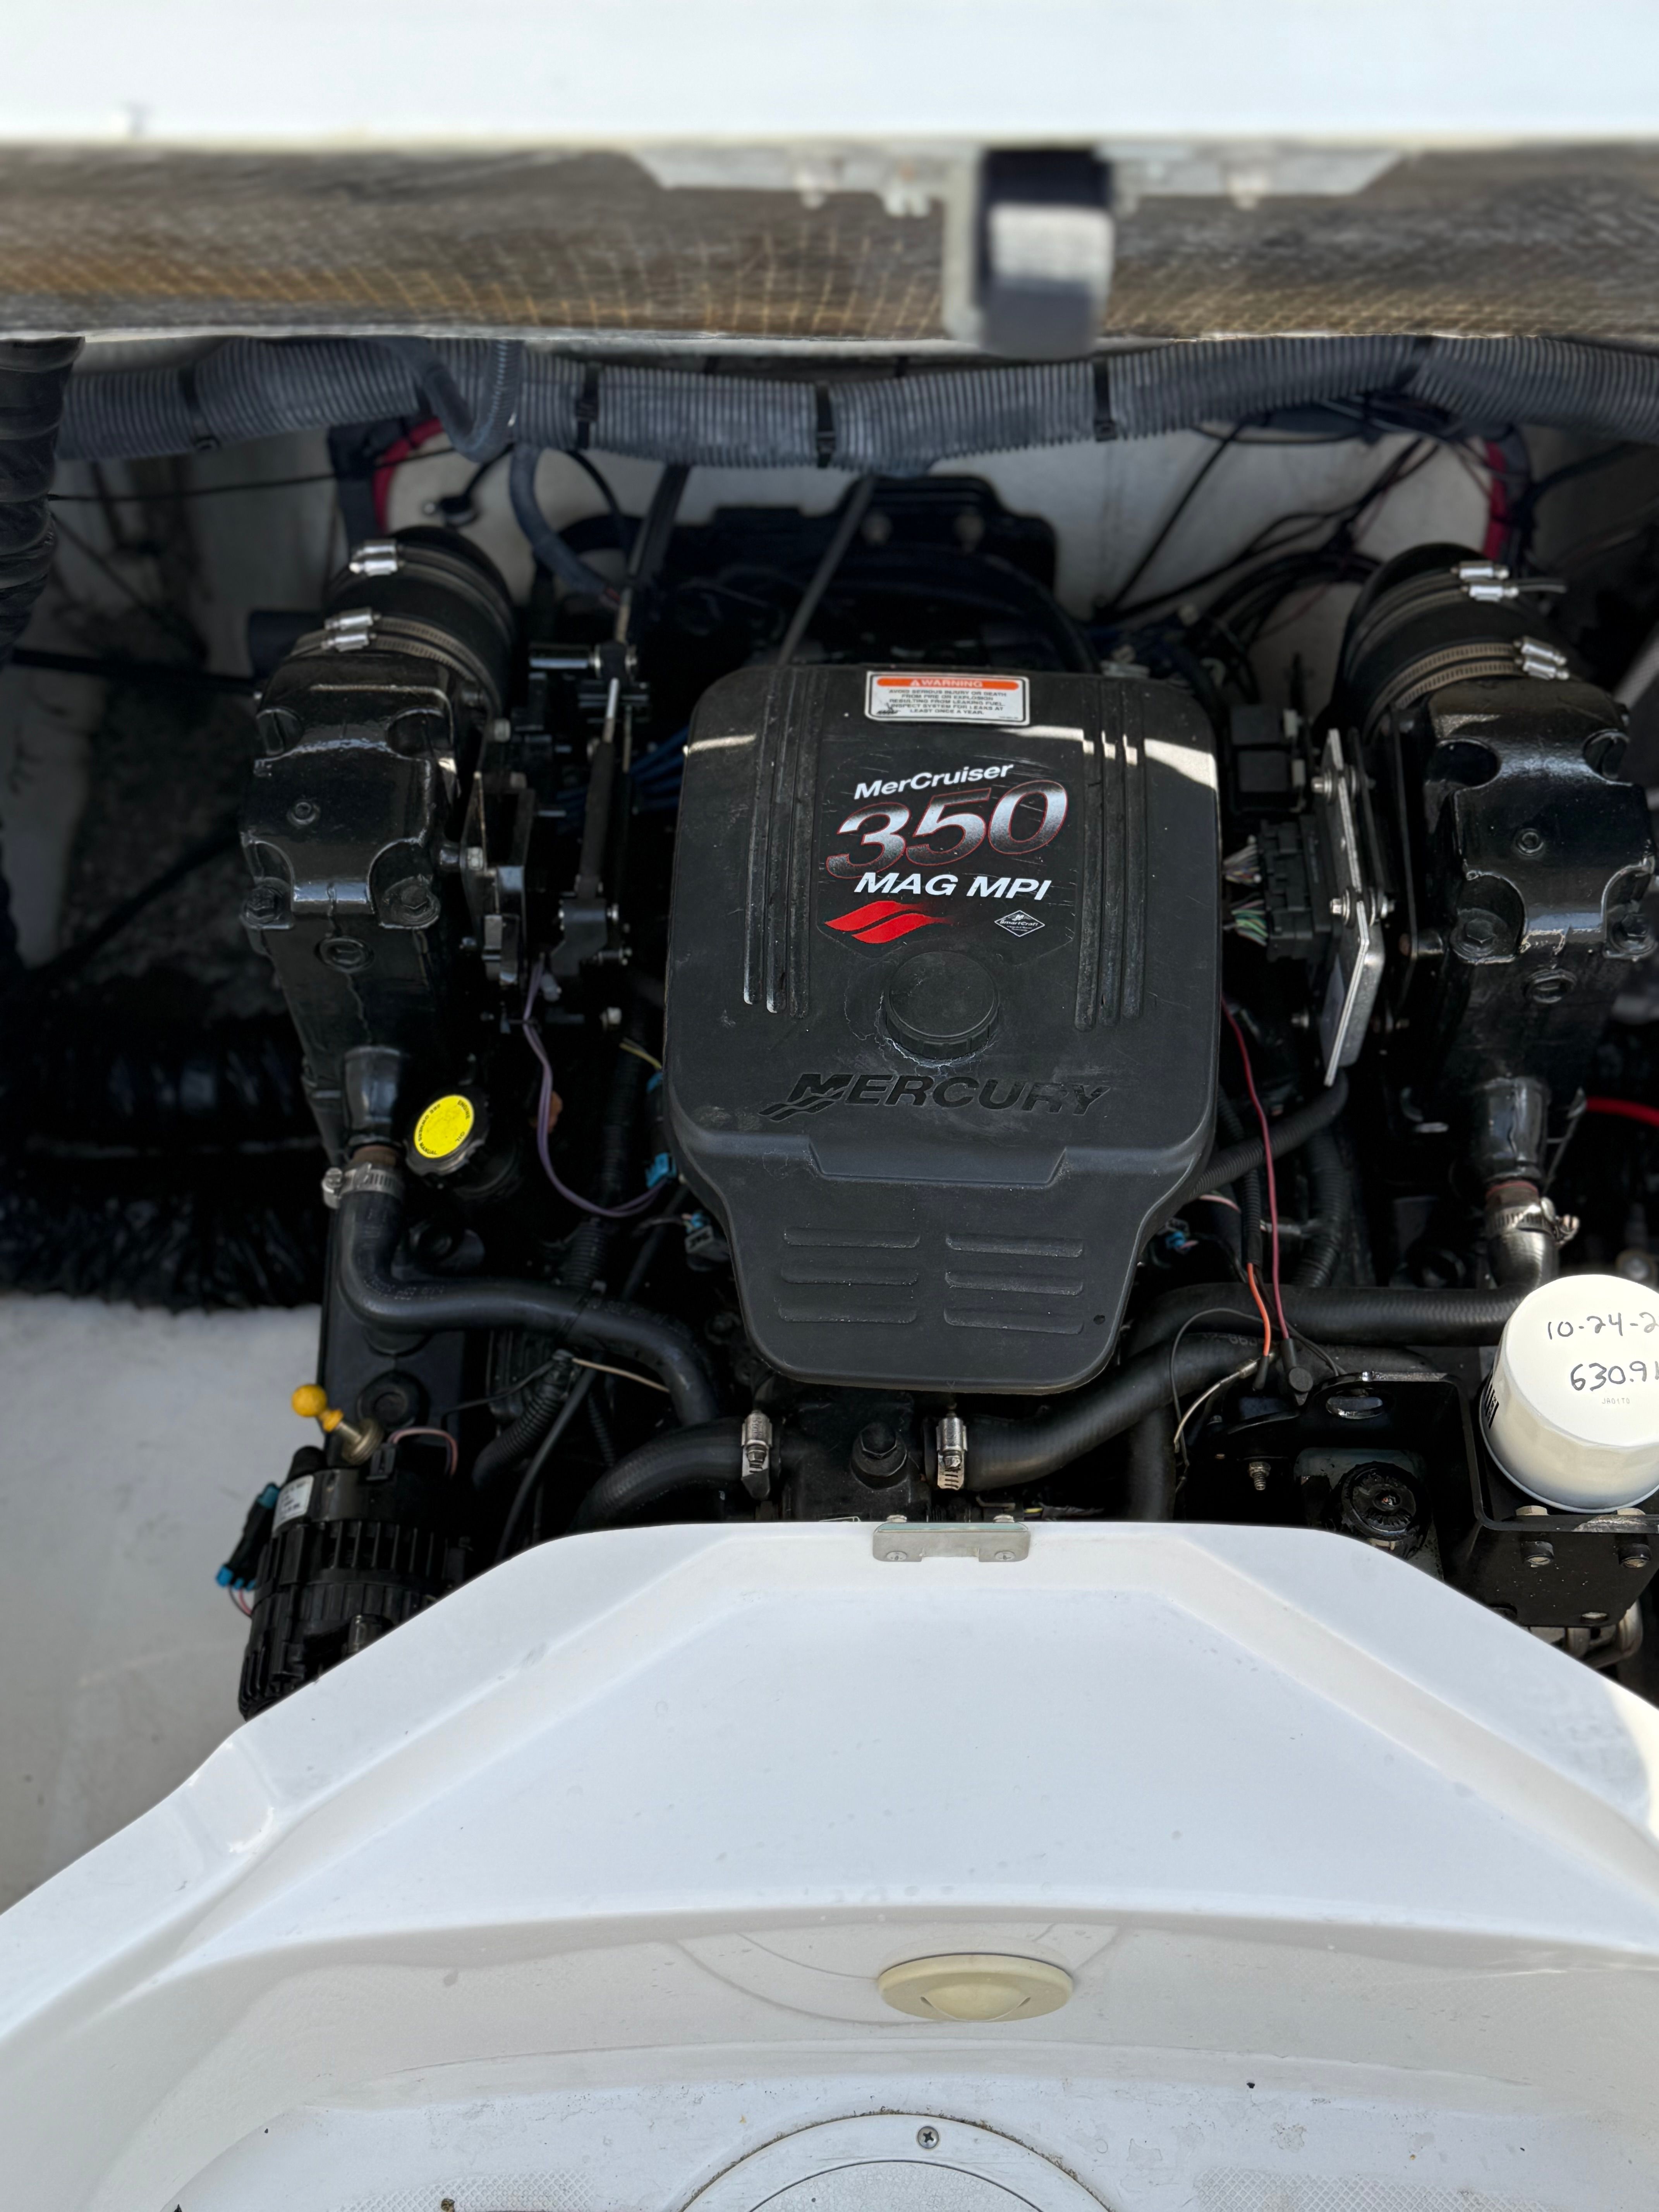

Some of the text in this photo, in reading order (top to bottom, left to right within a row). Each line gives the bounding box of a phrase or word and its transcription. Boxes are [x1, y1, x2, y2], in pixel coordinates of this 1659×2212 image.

[921, 679, 982, 687] WARNING
[854, 764, 1013, 800] MerCruiser
[826, 780, 1068, 878] 350
[854, 872, 1051, 900] MAG MPI
[457, 1100, 470, 1120] ENGINE
[757, 1073, 1111, 1122] MERCURY
[419, 1142, 437, 1155] MANUAL
[455, 1132, 465, 1142] OIL
[1547, 1312, 1659, 1340] 10-24-2
